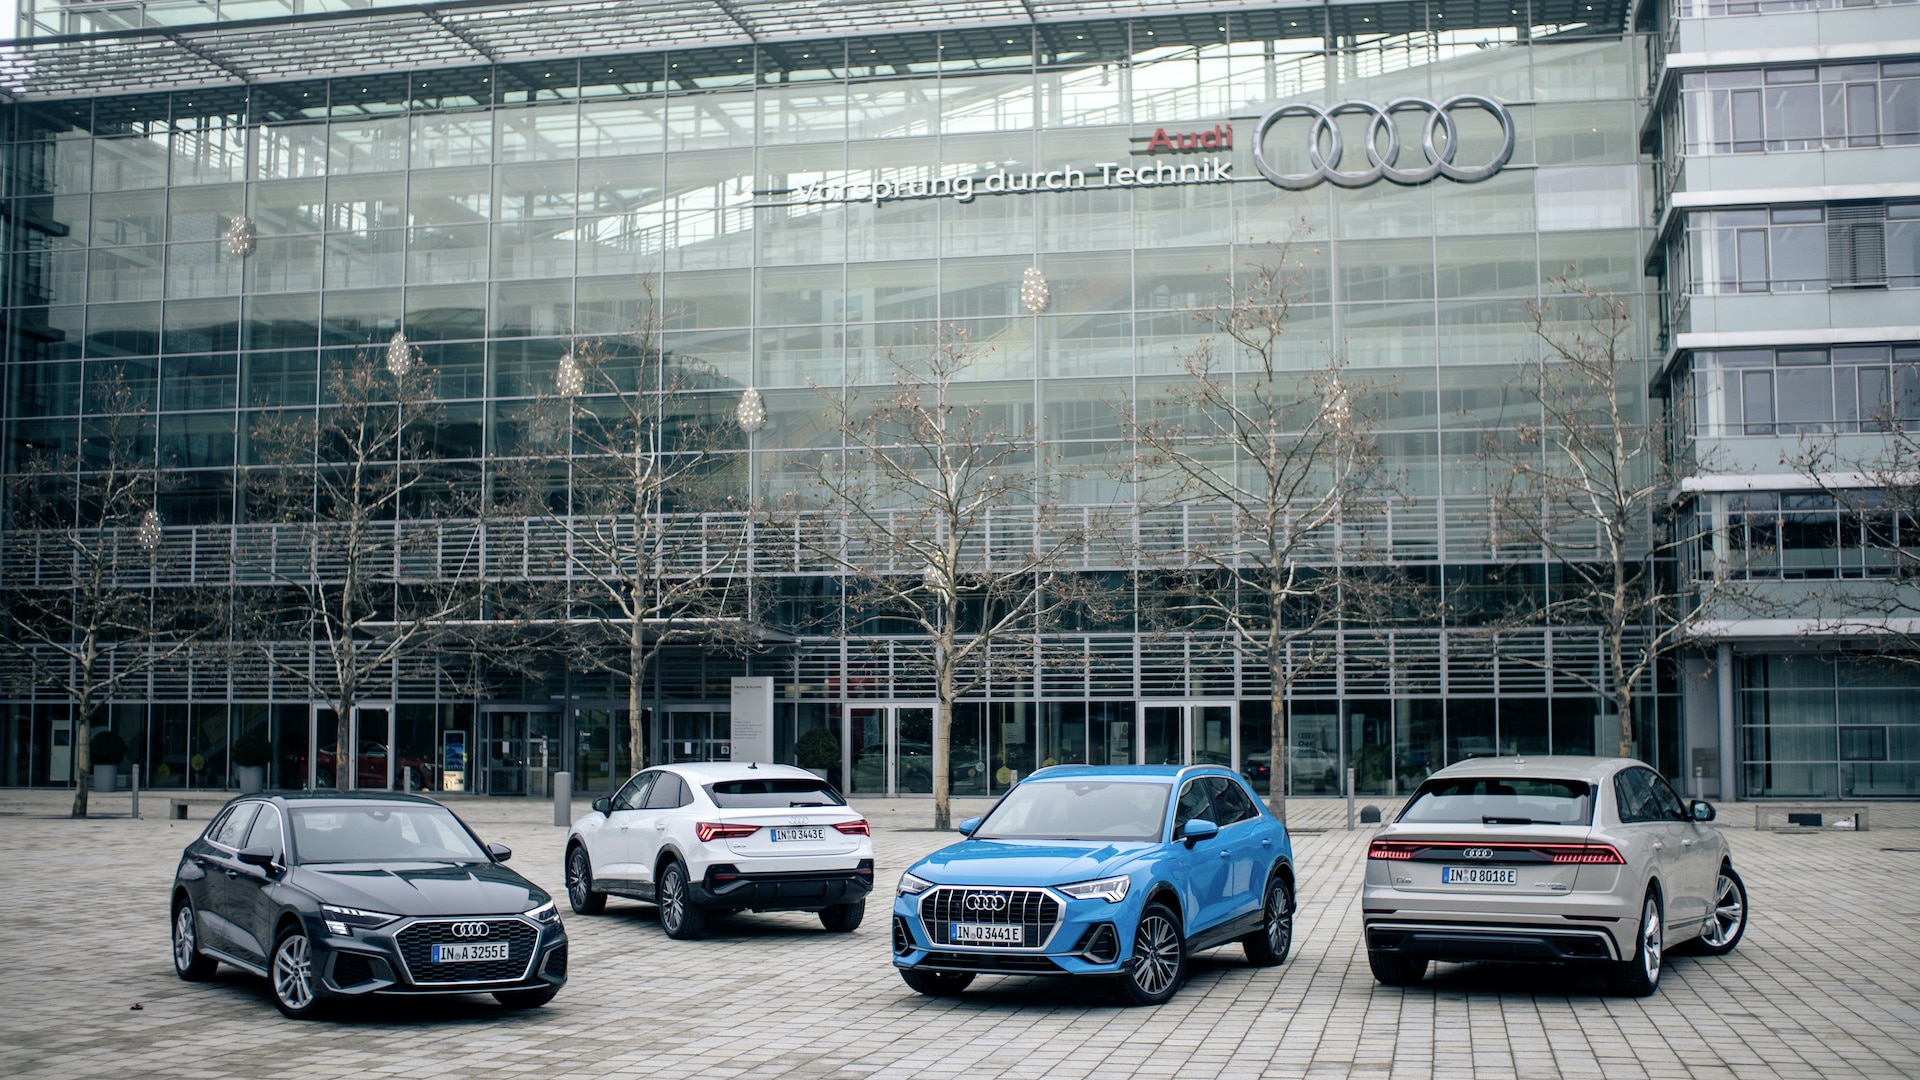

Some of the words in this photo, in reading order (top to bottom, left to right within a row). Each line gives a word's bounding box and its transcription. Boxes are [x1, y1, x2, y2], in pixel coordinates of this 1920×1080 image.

[1147, 122, 1232, 150] Audi
[796, 175, 973, 204] Vorsprung
[985, 165, 1084, 191] durch
[1095, 157, 1232, 185] Technik
[777, 830, 787, 840] IN
[1450, 869, 1463, 881] IN
[1470, 869, 1477, 882] Q
[958, 926, 970, 939] IN
[976, 926, 983, 939] Q
[440, 947, 454, 960] IN
[461, 946, 469, 959] A
